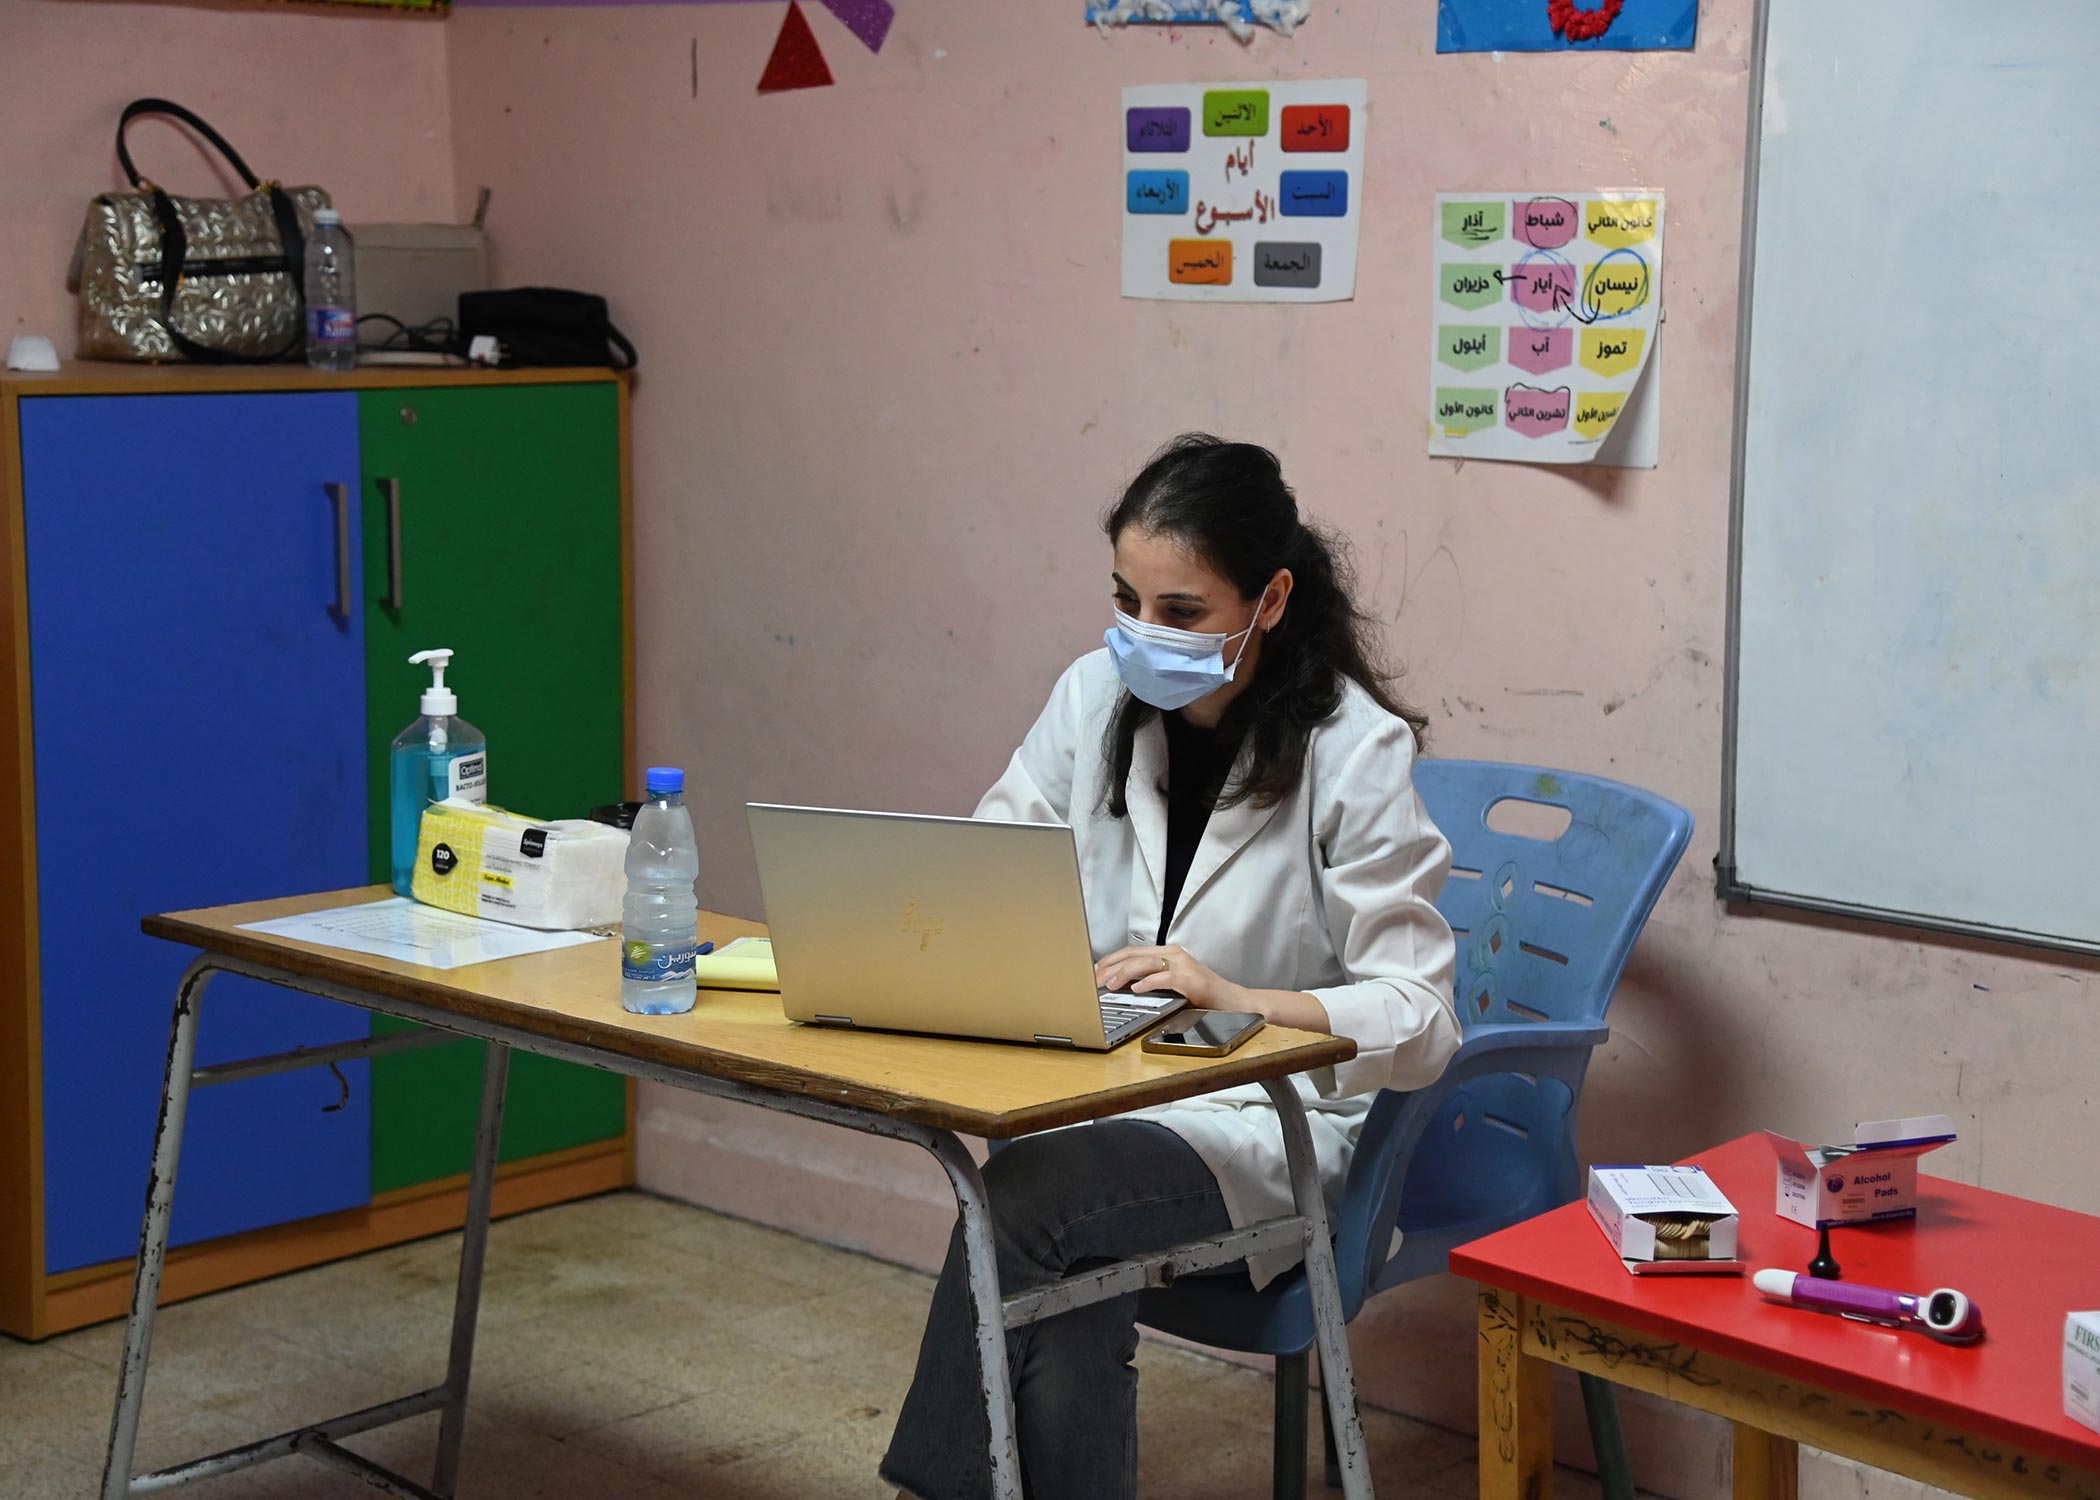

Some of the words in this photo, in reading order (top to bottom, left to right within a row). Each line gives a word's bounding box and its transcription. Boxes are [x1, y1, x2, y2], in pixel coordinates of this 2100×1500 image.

[1297, 113, 1333, 136] الأحد
[1224, 138, 1255, 184] أيام
[1291, 181, 1335, 205] السبت
[1194, 189, 1275, 235] الأسبوع
[1525, 211, 1564, 230] شباط
[1588, 215, 1618, 234] الثاني
[1621, 216, 1652, 231] كانون
[1175, 251, 1224, 274] الخميس
[1264, 253, 1310, 275] الجمعة
[1453, 275, 1490, 293] حزيران
[1595, 277, 1638, 295] نيسان
[1452, 333, 1486, 354] أيلول
[1532, 336, 1550, 357] آب
[1596, 340, 1627, 359] تموز
[1439, 402, 1464, 417] الأول
[1466, 403, 1494, 418] كانون
[1508, 405, 1535, 422] الثاني
[1536, 407, 1566, 422] تشرين
[436, 849, 450, 860] 120
[1854, 1172, 1891, 1185] Alcohol
[1874, 1187, 1899, 1198] Pads
